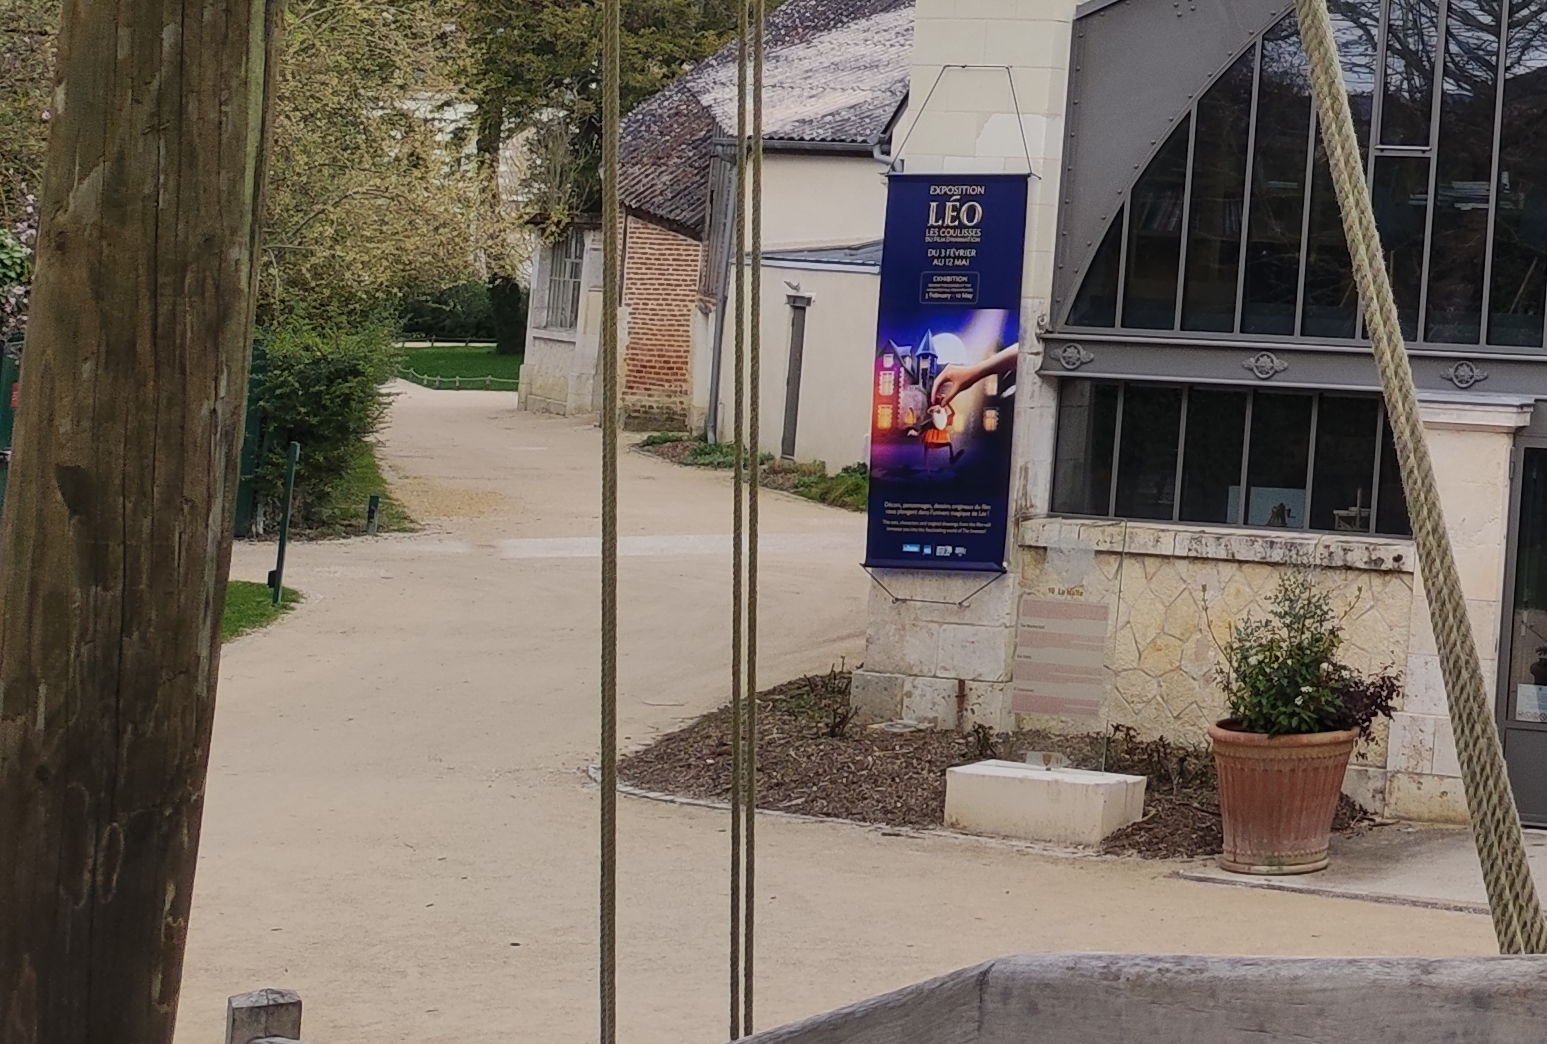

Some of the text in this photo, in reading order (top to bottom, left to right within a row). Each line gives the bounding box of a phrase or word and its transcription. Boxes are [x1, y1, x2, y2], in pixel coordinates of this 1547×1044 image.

[930, 185, 985, 195] EXPOSITION
[927, 195, 983, 227] LÉO
[925, 228, 982, 237] LES COULISSES
[928, 247, 977, 257] DU 3 FÉVRIER
[932, 258, 970, 266] AU 12 MAI
